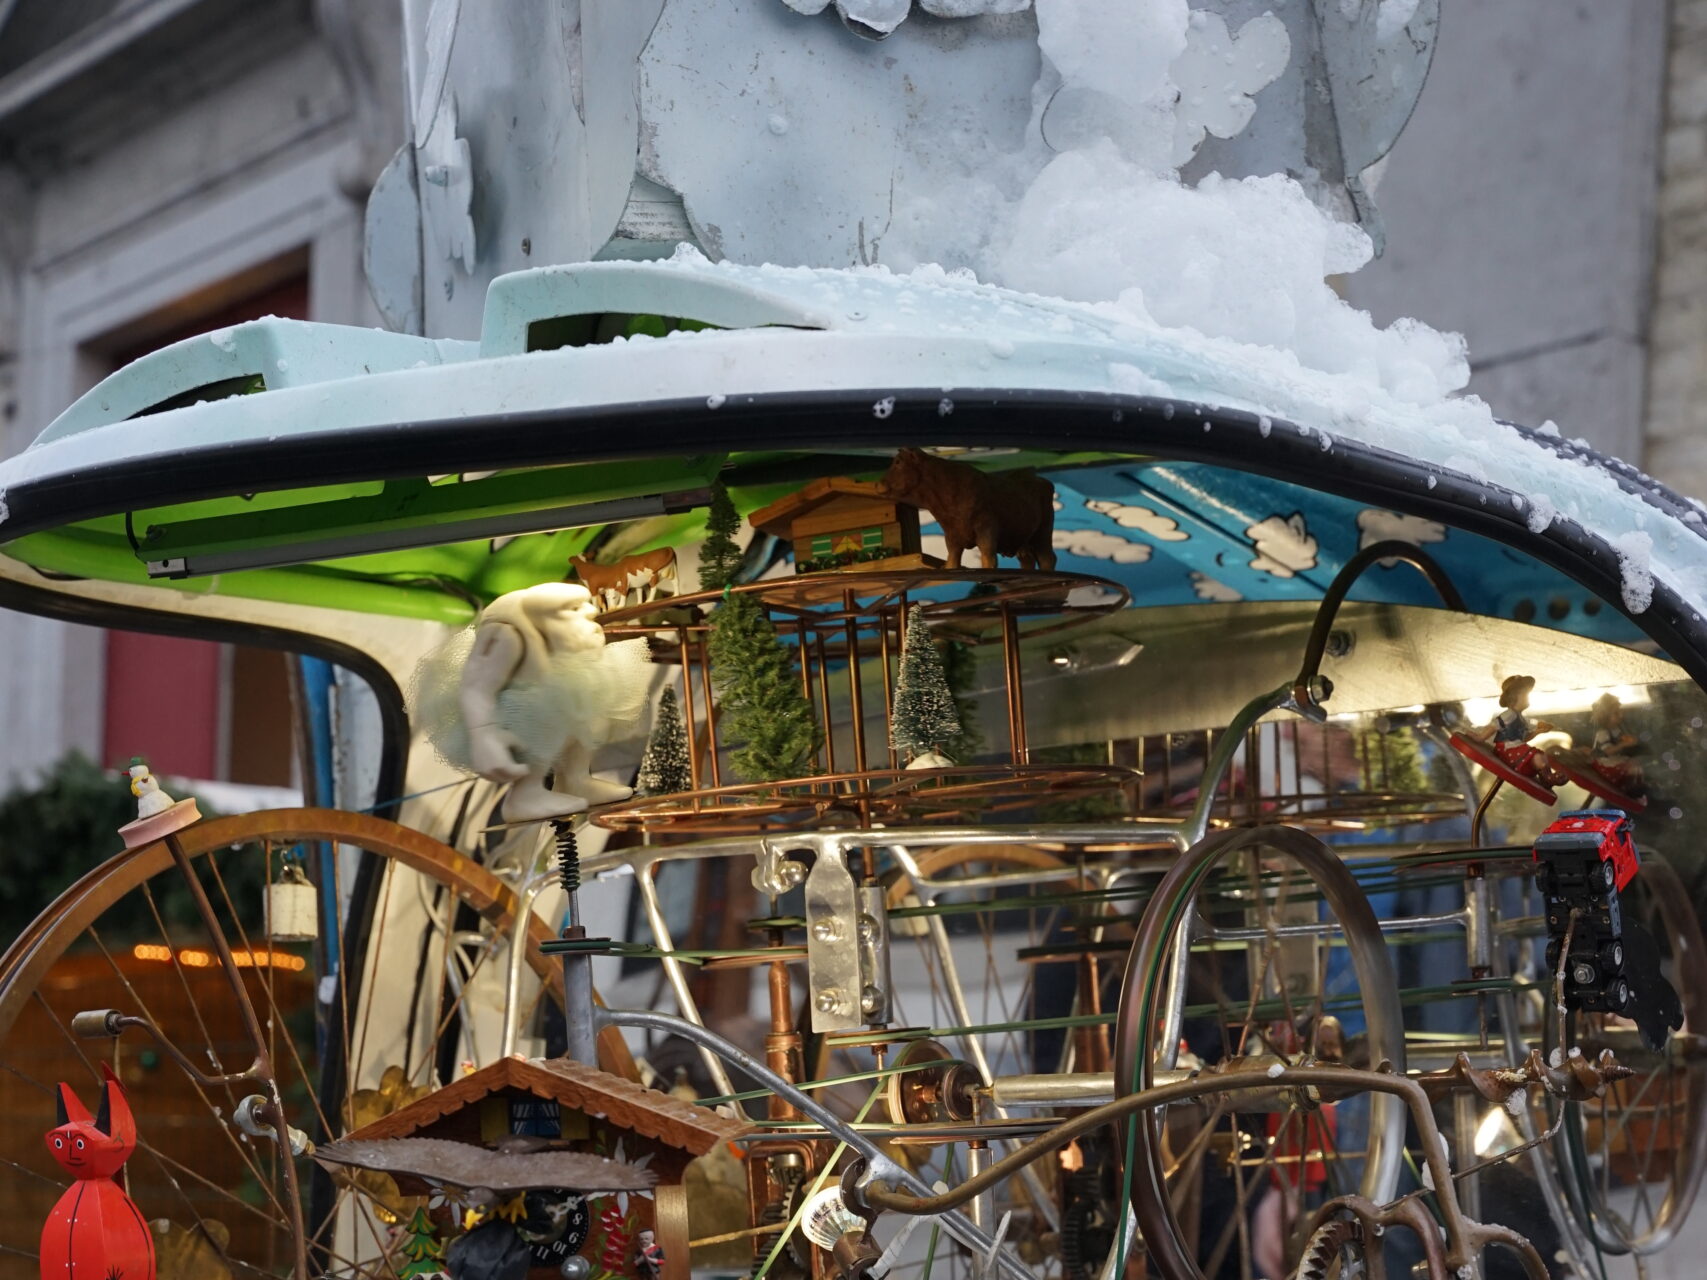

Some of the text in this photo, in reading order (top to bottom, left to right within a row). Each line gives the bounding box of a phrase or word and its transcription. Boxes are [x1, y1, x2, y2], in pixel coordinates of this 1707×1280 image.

[572, 1213, 583, 1225] 8
[536, 1246, 550, 1260] 11
[552, 1240, 567, 1255] 10
